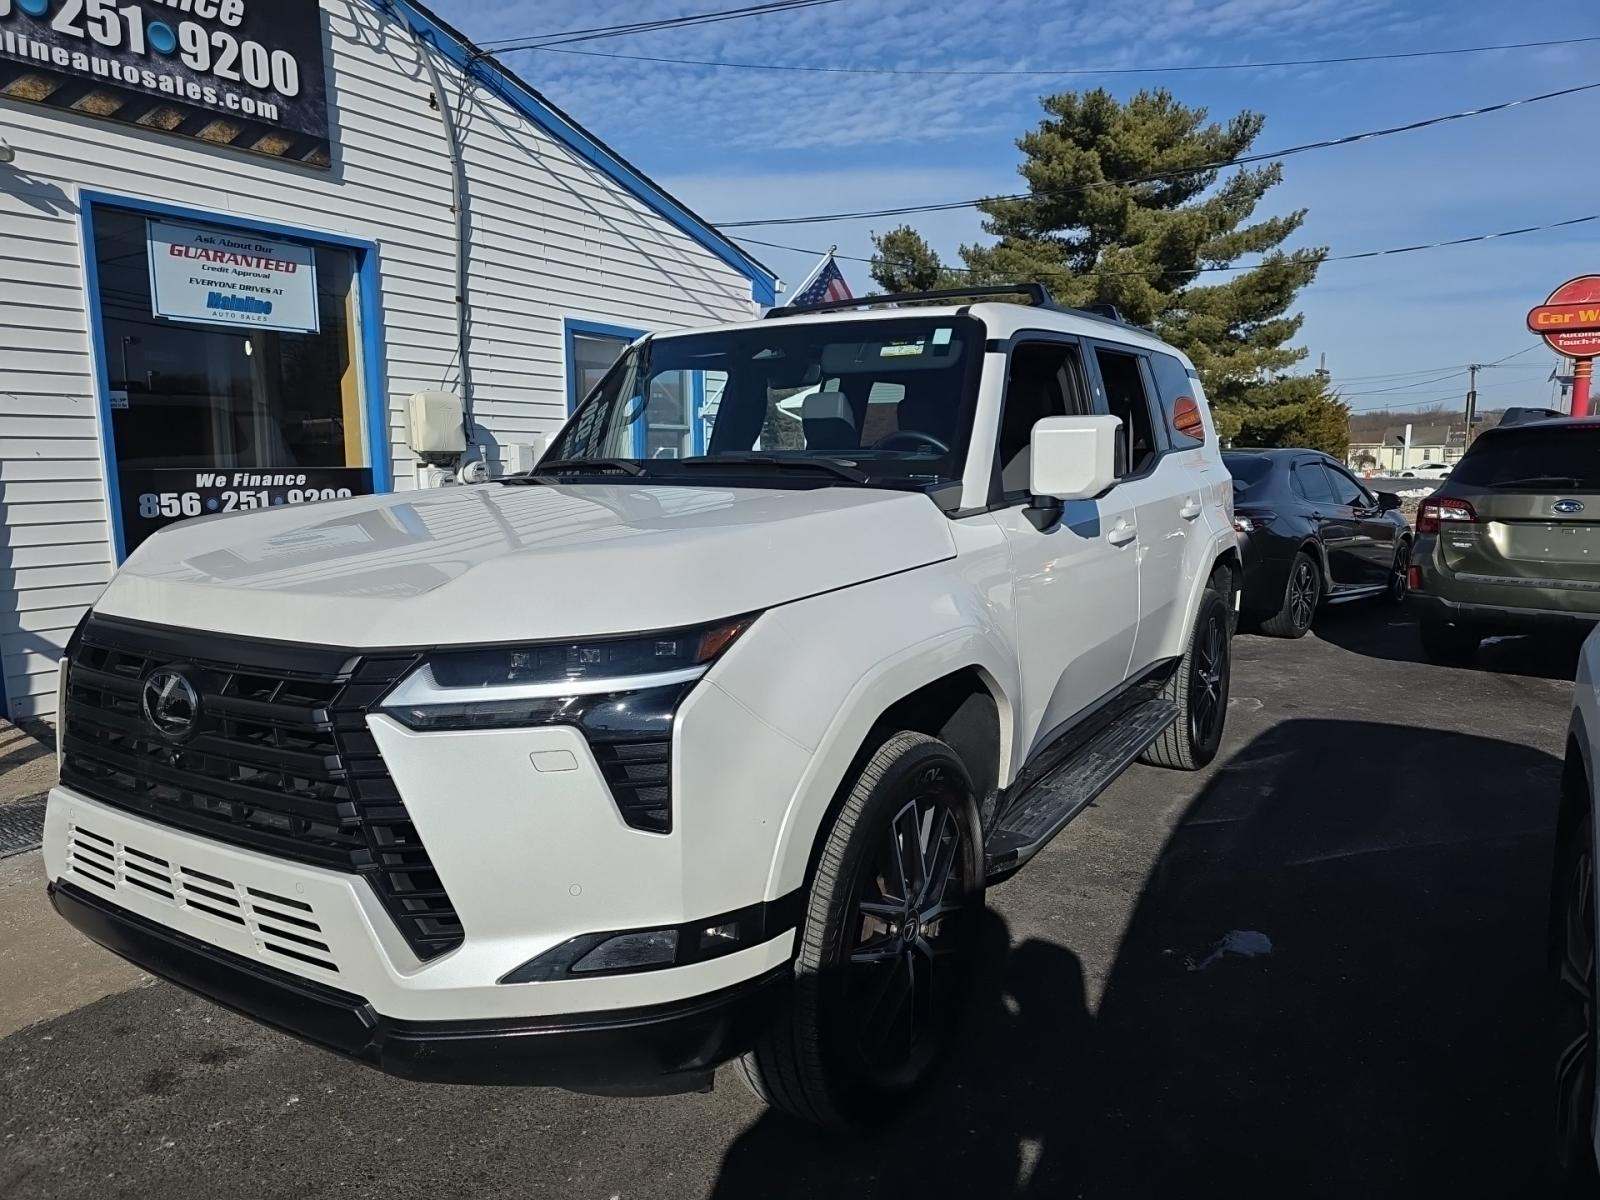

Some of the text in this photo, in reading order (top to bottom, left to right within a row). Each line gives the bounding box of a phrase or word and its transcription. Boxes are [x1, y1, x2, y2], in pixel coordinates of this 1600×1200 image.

[0, 30, 279, 121] lineautosales.com
[194, 234, 275, 254] Ask About Our
[169, 243, 298, 274] GUARANTEED
[201, 263, 271, 280] Credit Approval
[189, 277, 285, 296] EVERYONE DRIVES AT
[212, 311, 269, 322] AUTO SALES
[1537, 309, 1600, 324] Car W
[196, 473, 307, 488] We Finance
